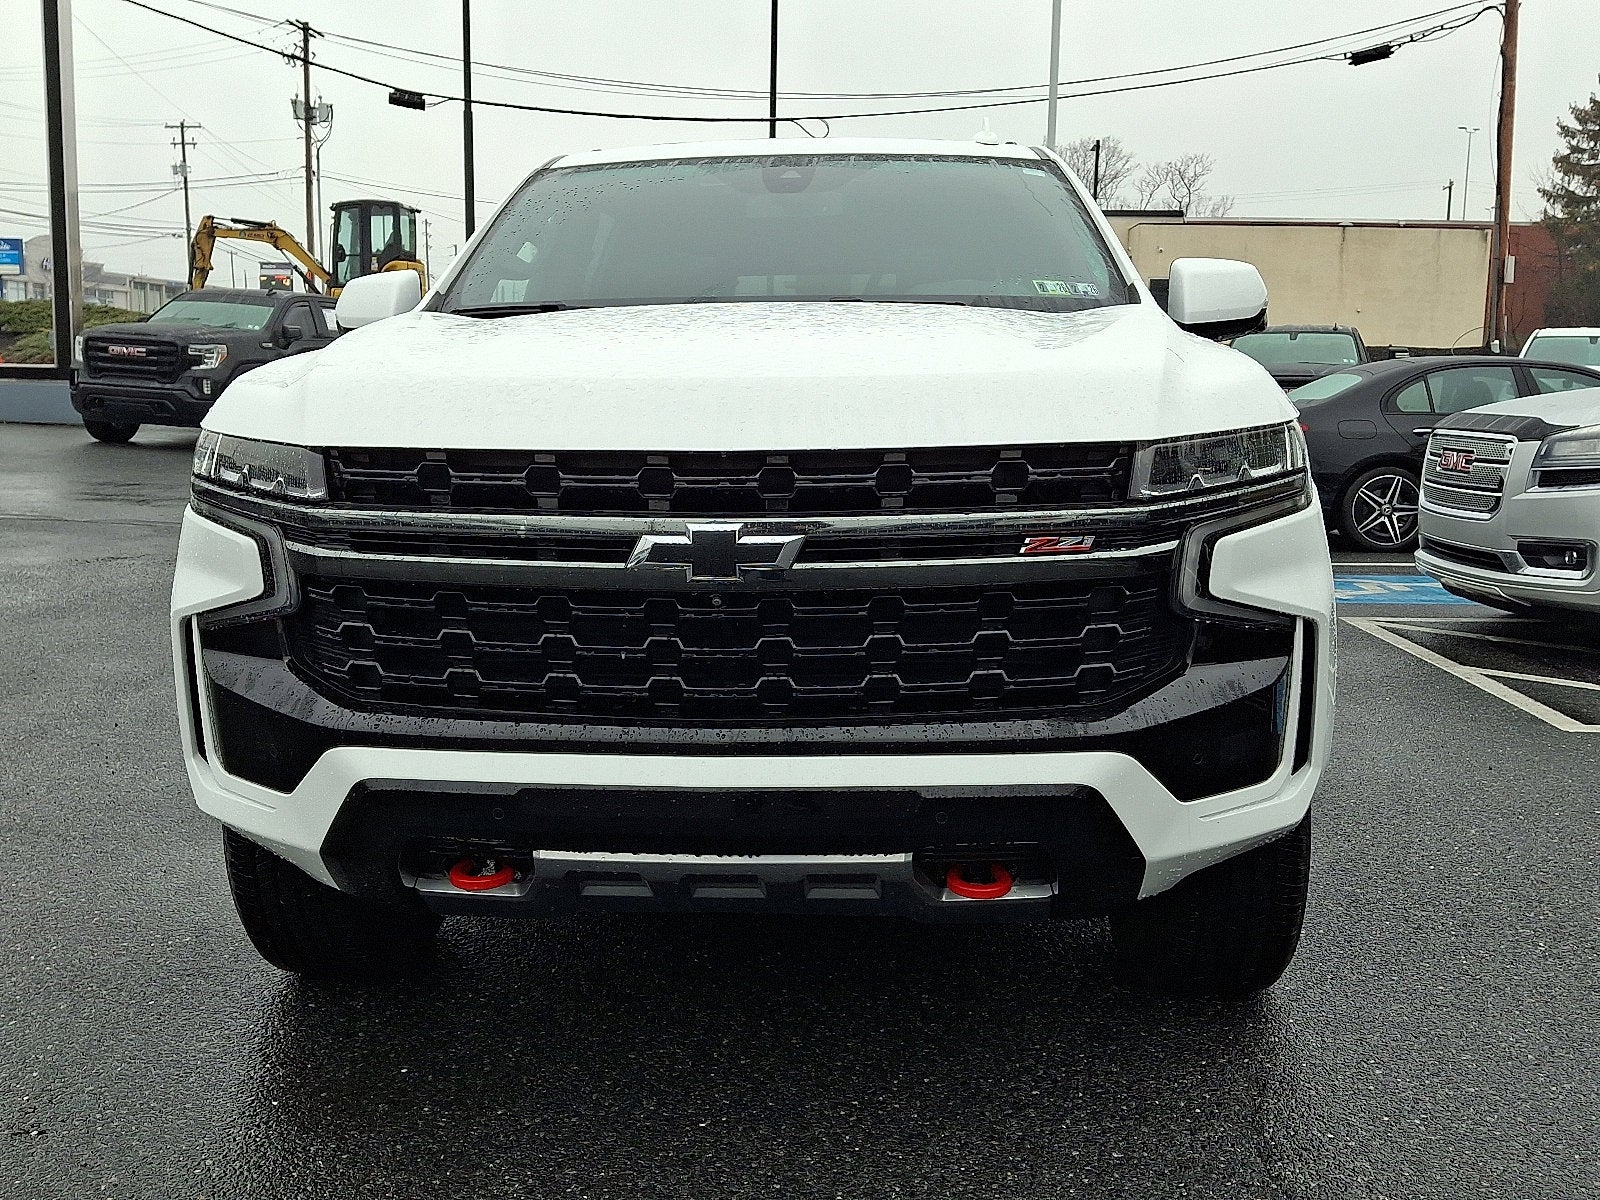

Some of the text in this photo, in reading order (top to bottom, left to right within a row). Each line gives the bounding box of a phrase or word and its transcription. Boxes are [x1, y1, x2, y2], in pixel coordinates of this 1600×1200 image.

[108, 345, 147, 357] GMC
[1440, 450, 1475, 471] GMC
[1019, 536, 1096, 553] Z71
